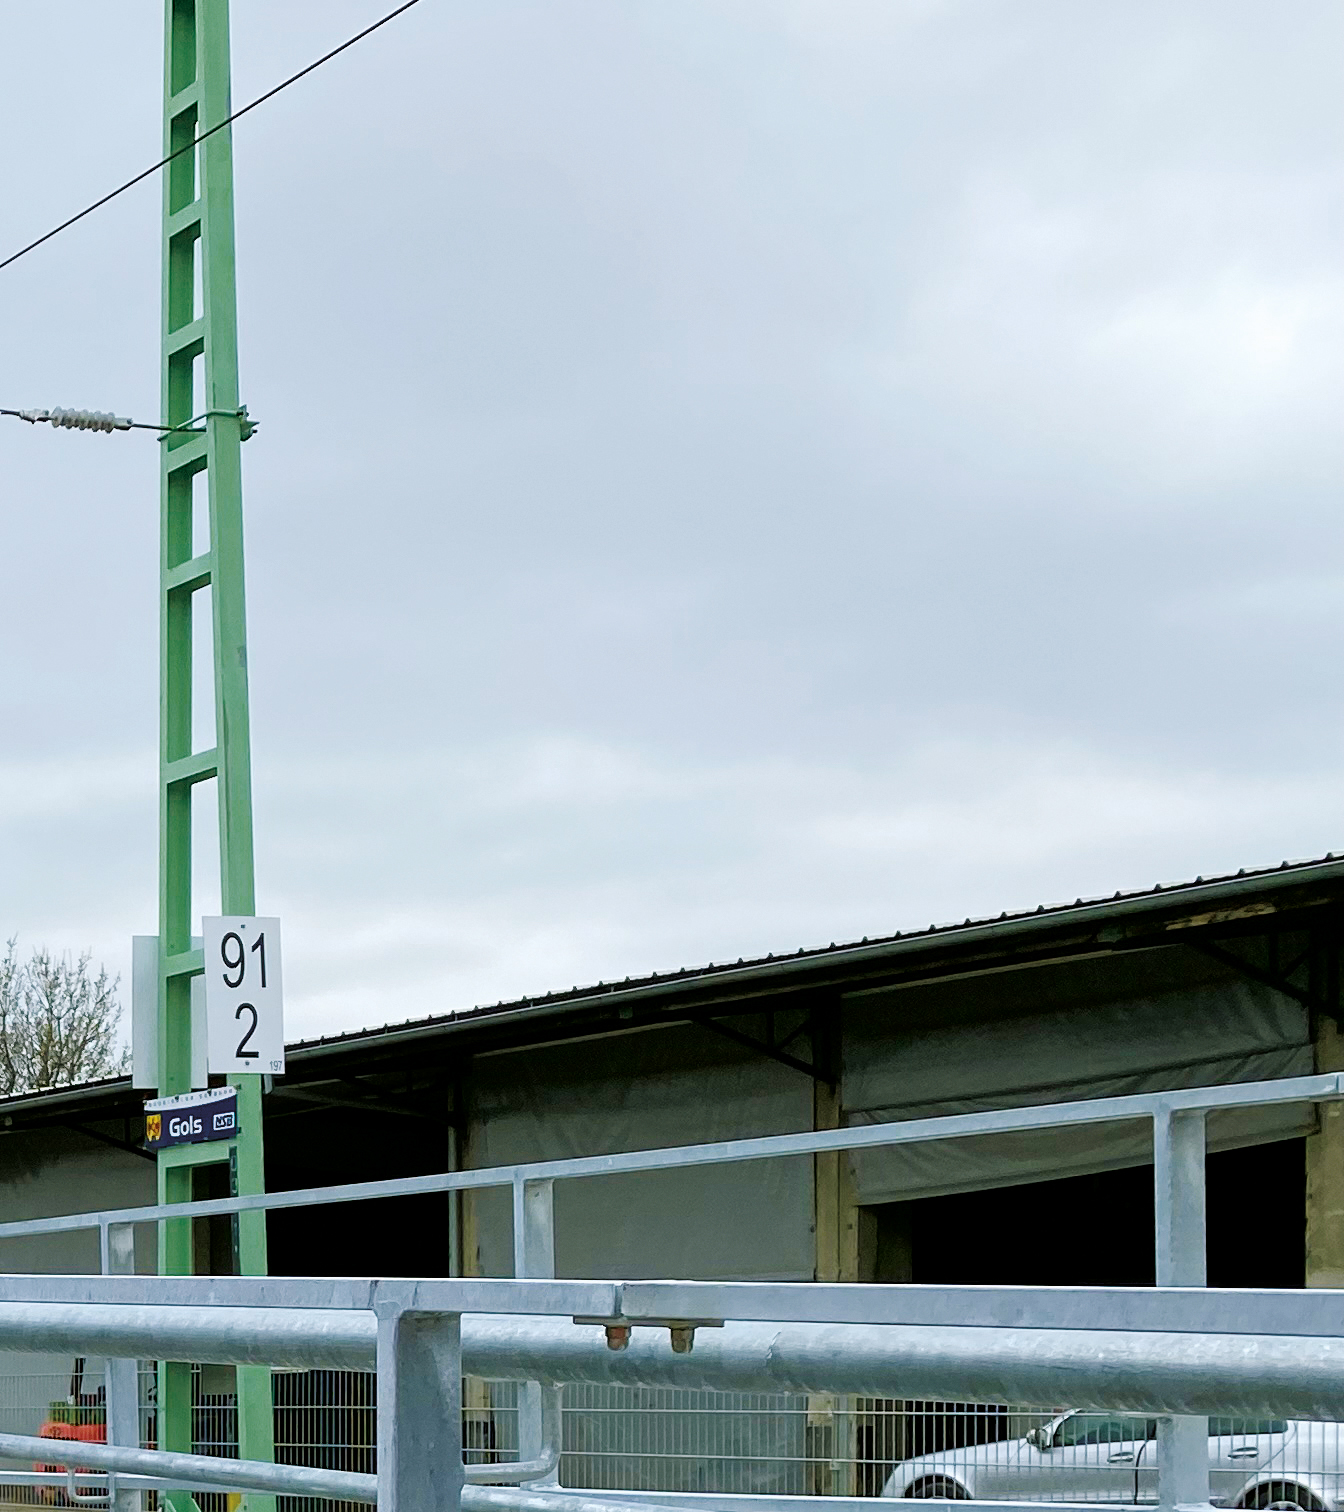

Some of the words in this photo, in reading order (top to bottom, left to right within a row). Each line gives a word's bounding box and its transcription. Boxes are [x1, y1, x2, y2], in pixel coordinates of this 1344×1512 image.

[221, 932, 267, 989] 91
[235, 1002, 260, 1059] 2
[269, 1060, 283, 1072] 197
[169, 1115, 203, 1137] Gols
